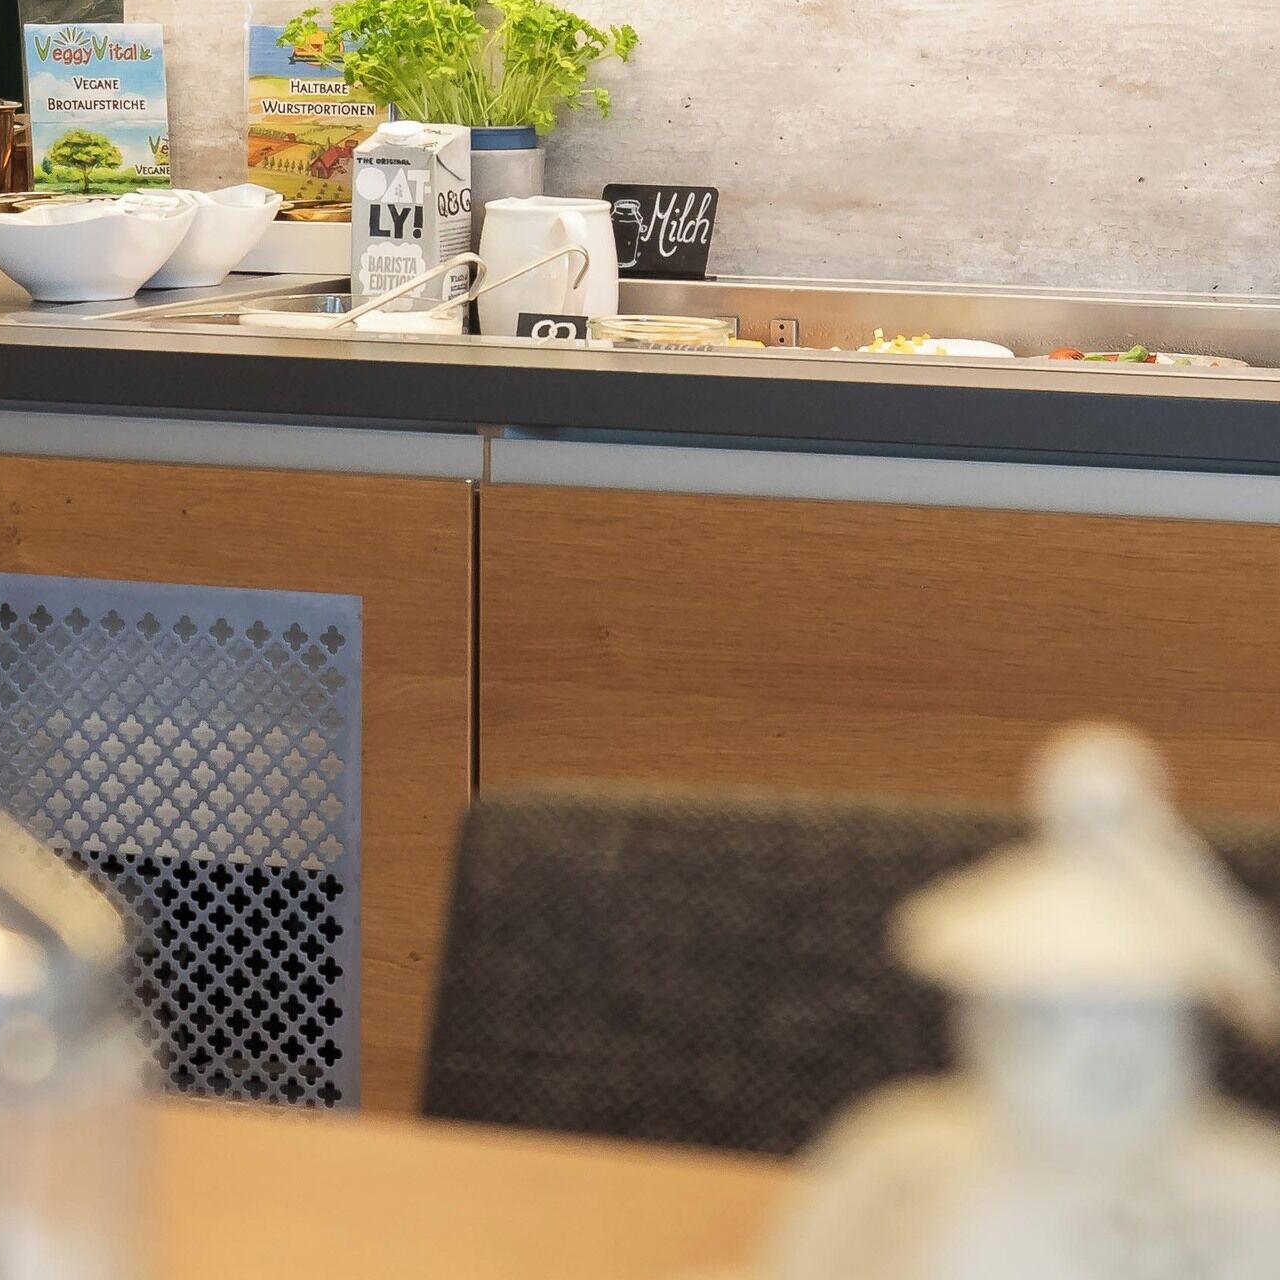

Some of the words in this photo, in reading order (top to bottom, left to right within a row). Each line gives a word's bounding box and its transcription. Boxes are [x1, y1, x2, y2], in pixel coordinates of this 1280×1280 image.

[73, 77, 120, 90] VEGANE
[290, 80, 349, 95] HALTBARE
[47, 97, 147, 111] BROTAUFSTRICHE
[262, 100, 376, 116] WURSTPORTIONEN
[356, 157, 374, 165] THE
[369, 204, 424, 239] LY!
[640, 191, 713, 258] Milch
[368, 255, 417, 274] BARISTA
